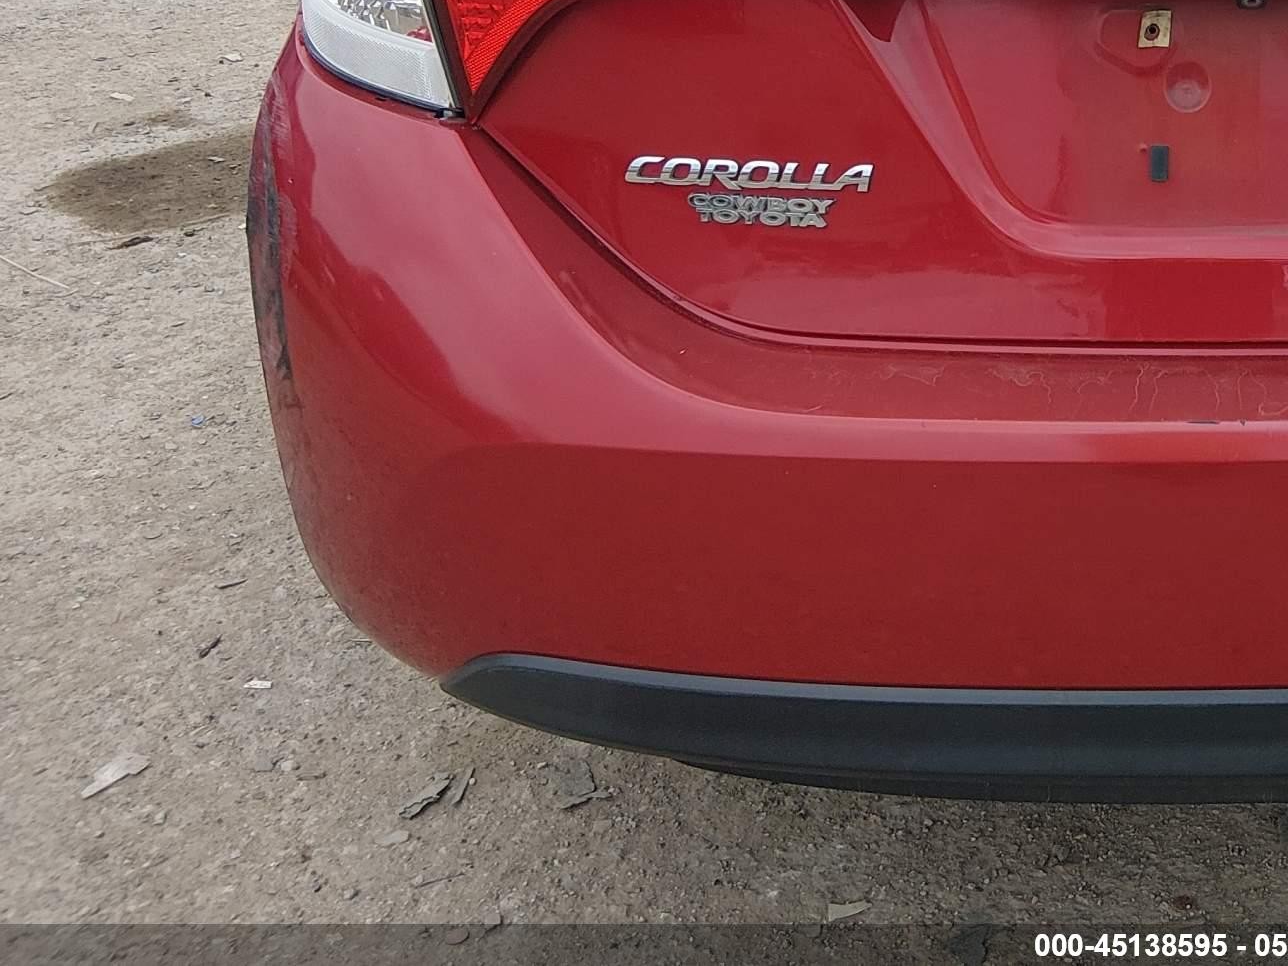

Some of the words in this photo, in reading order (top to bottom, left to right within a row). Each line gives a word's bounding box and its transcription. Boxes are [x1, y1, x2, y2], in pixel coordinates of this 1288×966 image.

[624, 155, 874, 193] COROLLA
[688, 192, 836, 215] COWBOY
[696, 208, 828, 228] TOYOTA
